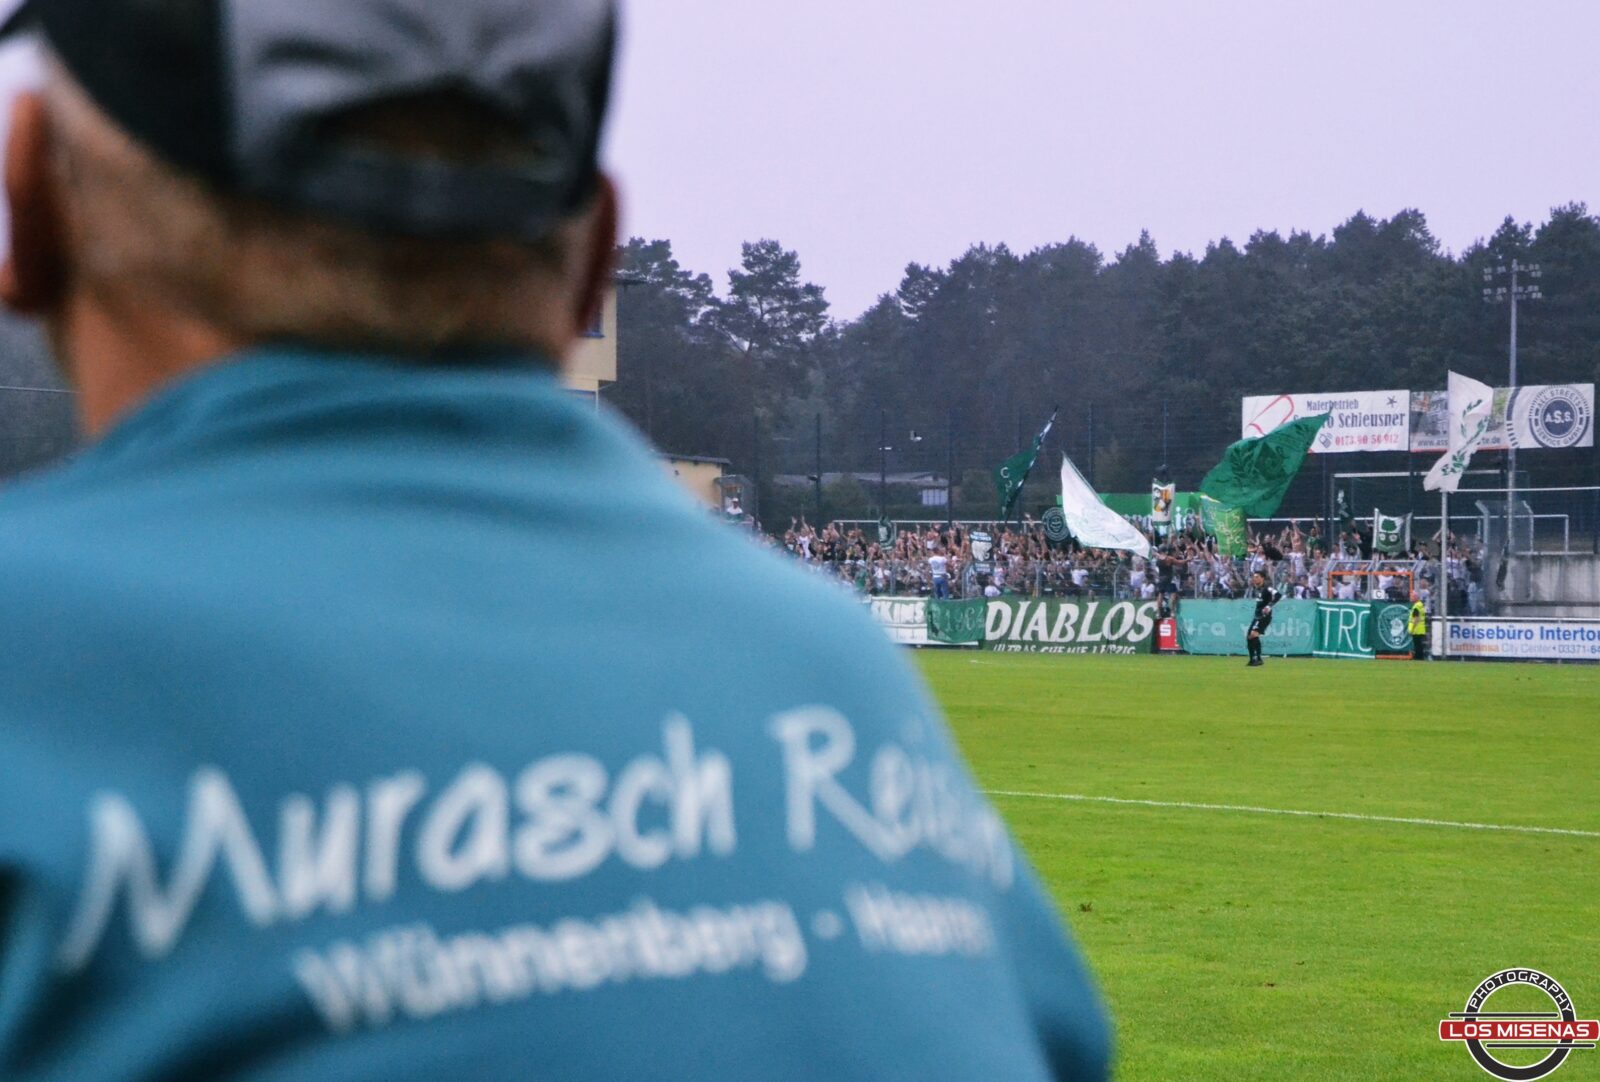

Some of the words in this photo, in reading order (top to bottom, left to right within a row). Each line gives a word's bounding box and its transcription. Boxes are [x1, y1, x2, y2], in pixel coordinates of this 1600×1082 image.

[1338, 411, 1406, 429] Schleusner
[985, 600, 1157, 643] DIABLOS
[1450, 624, 1534, 641] Reisebüro
[1539, 626, 1600, 642] Interto
